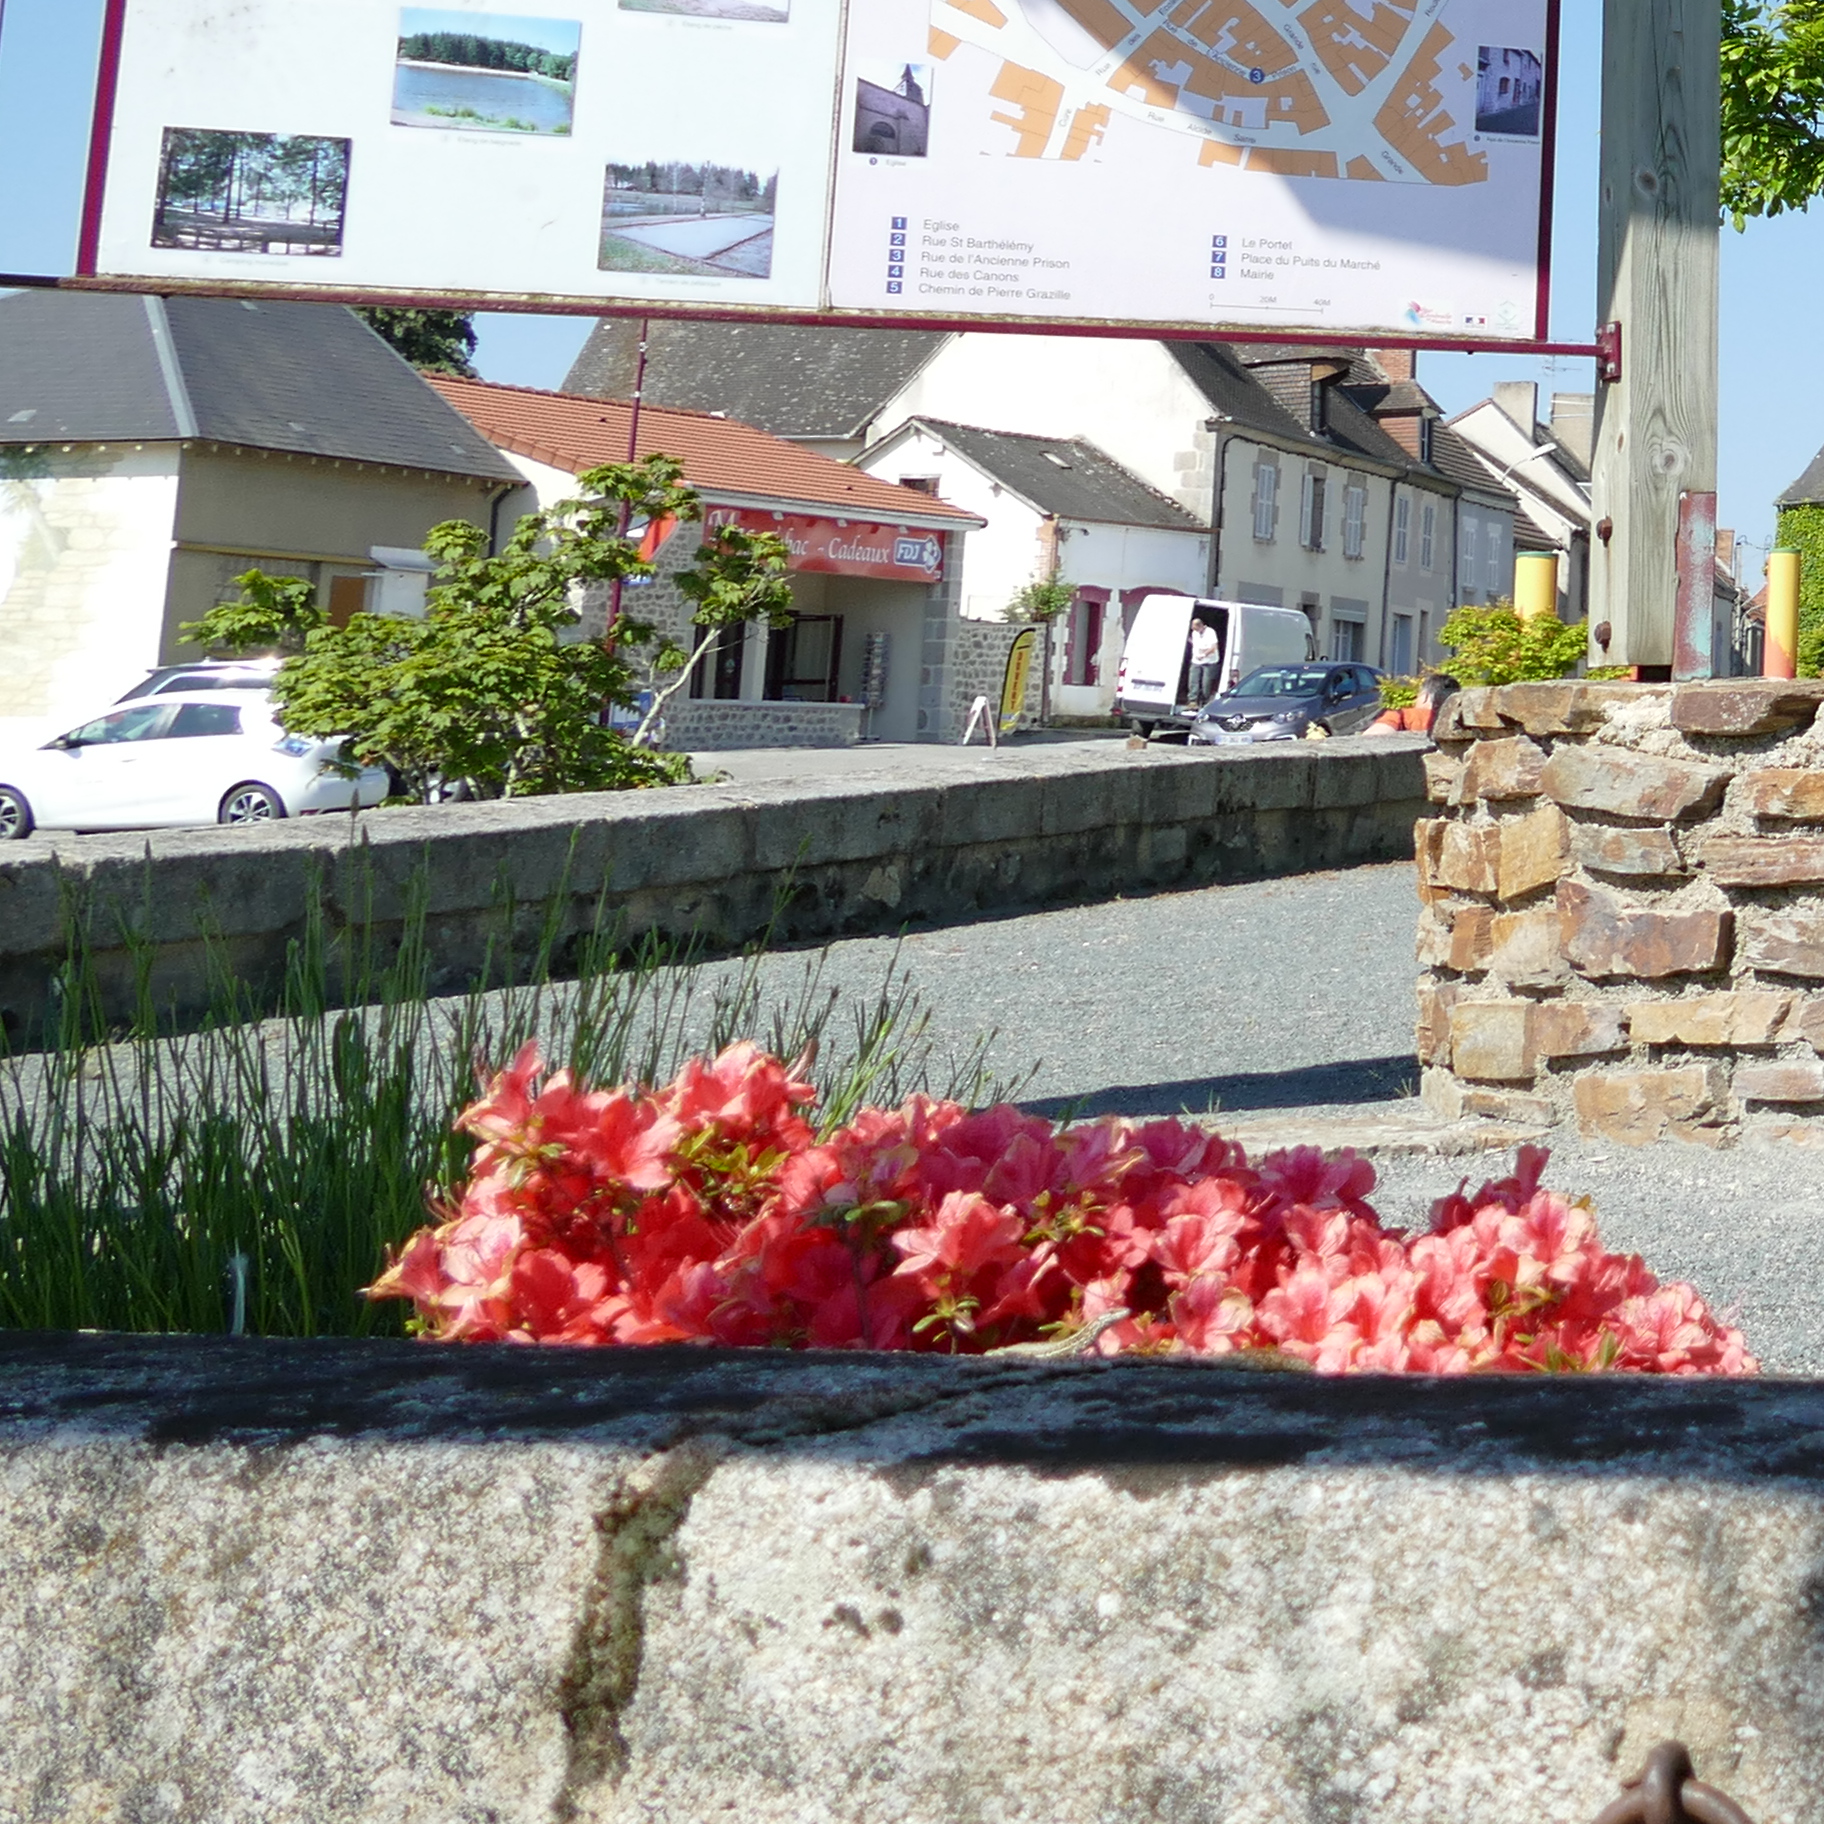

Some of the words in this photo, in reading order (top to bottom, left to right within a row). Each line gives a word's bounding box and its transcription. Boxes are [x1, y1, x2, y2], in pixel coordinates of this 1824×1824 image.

[923, 219, 960, 233] Eglise
[922, 235, 947, 248] Rue
[950, 237, 963, 249] St
[1241, 237, 1256, 249] Le
[921, 251, 946, 263] Rue
[949, 253, 964, 264] de
[967, 254, 1029, 268] l'Ancienne
[1032, 257, 1070, 269] Prison
[1241, 253, 1273, 265] Place
[1275, 255, 1290, 266] du
[1293, 256, 1321, 268] Puits
[1323, 257, 1337, 268] du
[1340, 258, 1381, 271] Marché
[920, 267, 944, 279] Rue
[947, 268, 970, 281] des
[973, 270, 1020, 283] Canons
[1240, 268, 1274, 280] Mairie
[918, 282, 965, 295] Chemin
[968, 285, 984, 297] de
[987, 285, 1023, 298] Pierre
[1026, 287, 1072, 301] Grazille
[827, 534, 890, 564] Cadeaux
[896, 542, 920, 561] FDJ
